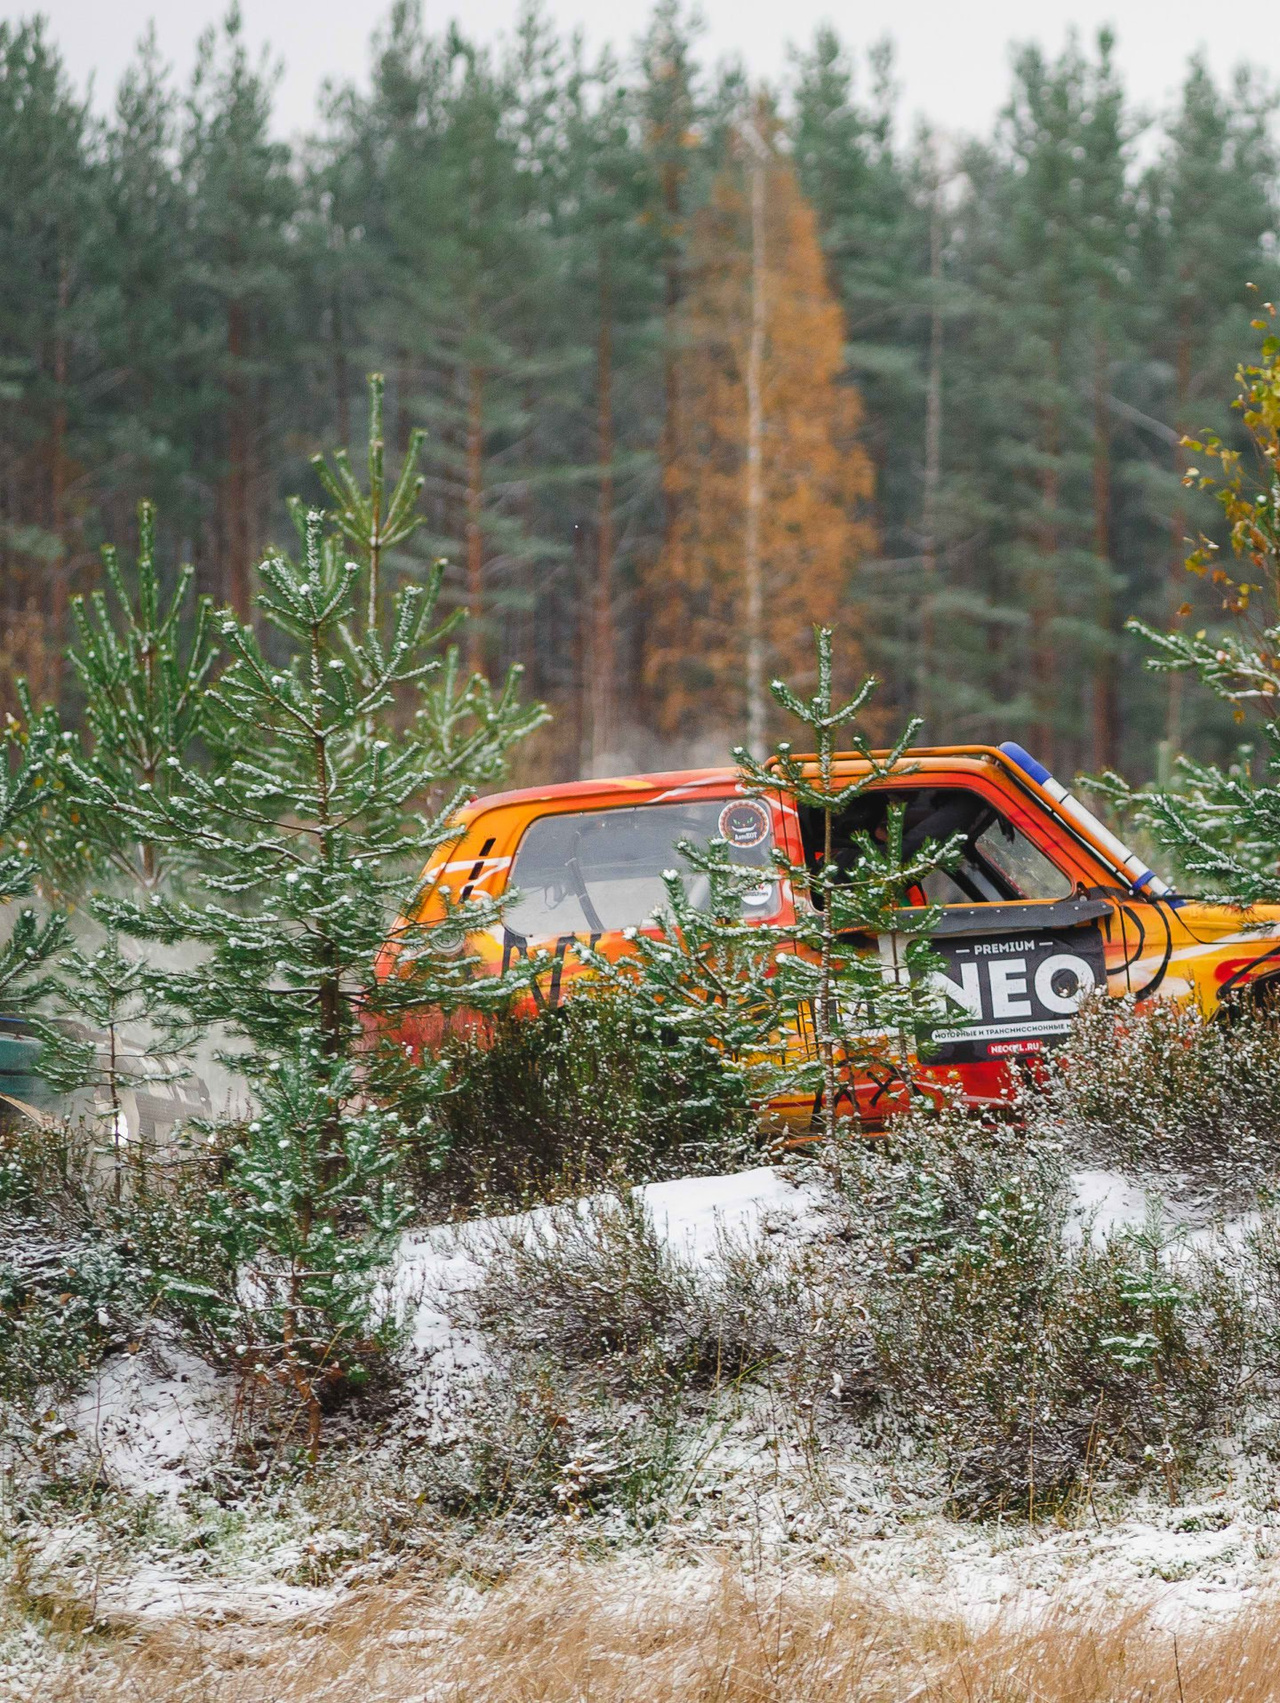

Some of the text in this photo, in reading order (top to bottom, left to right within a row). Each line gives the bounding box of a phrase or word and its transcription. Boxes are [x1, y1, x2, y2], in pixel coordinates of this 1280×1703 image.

[974, 940, 1035, 955] PREMIUM
[925, 954, 1095, 1020] NEO
[934, 1029, 977, 1039] МОТОРНЫЕ
[986, 1023, 1065, 1035] ТРАНСМИССИОННЫЕ
